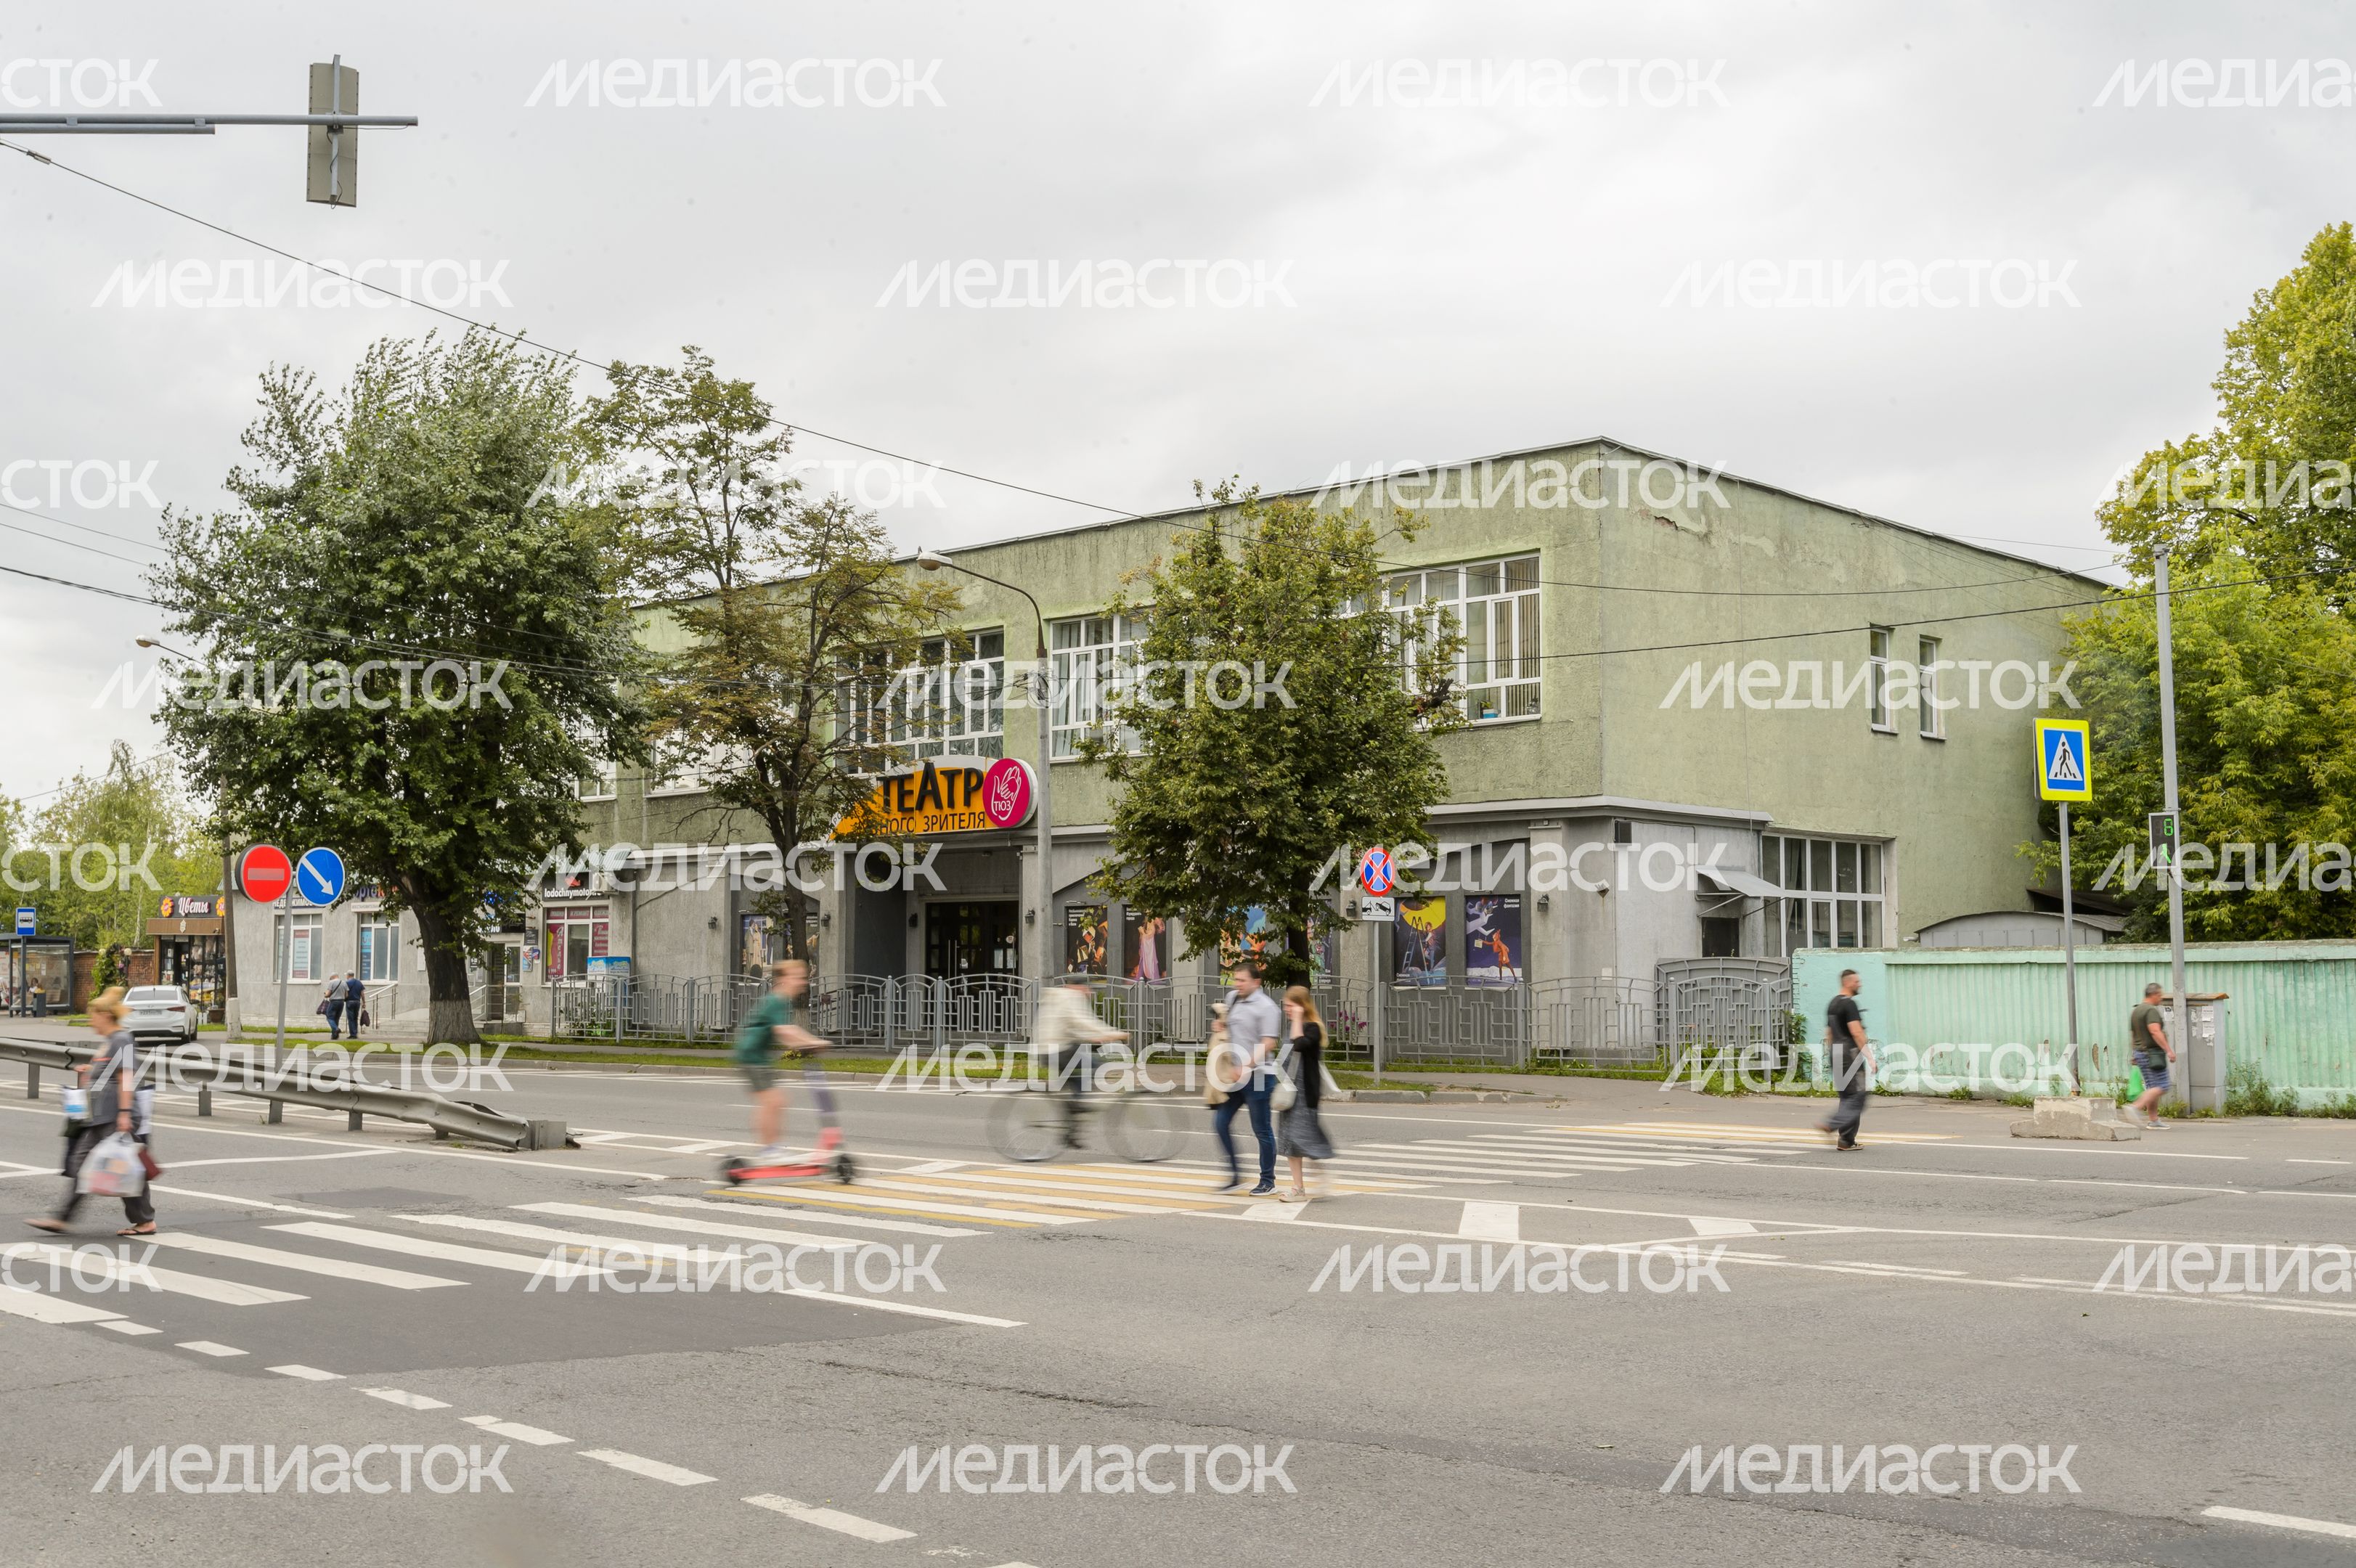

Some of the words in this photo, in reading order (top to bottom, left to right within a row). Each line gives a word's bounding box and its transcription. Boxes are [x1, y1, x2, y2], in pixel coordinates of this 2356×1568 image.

[876, 762, 984, 813] ТЕАТР
[993, 800, 1011, 812] ТЮЗ
[870, 817, 917, 837] НОГО
[923, 812, 985, 832] ЗРИТЕЛЯ
[178, 897, 209, 916] Цветы
